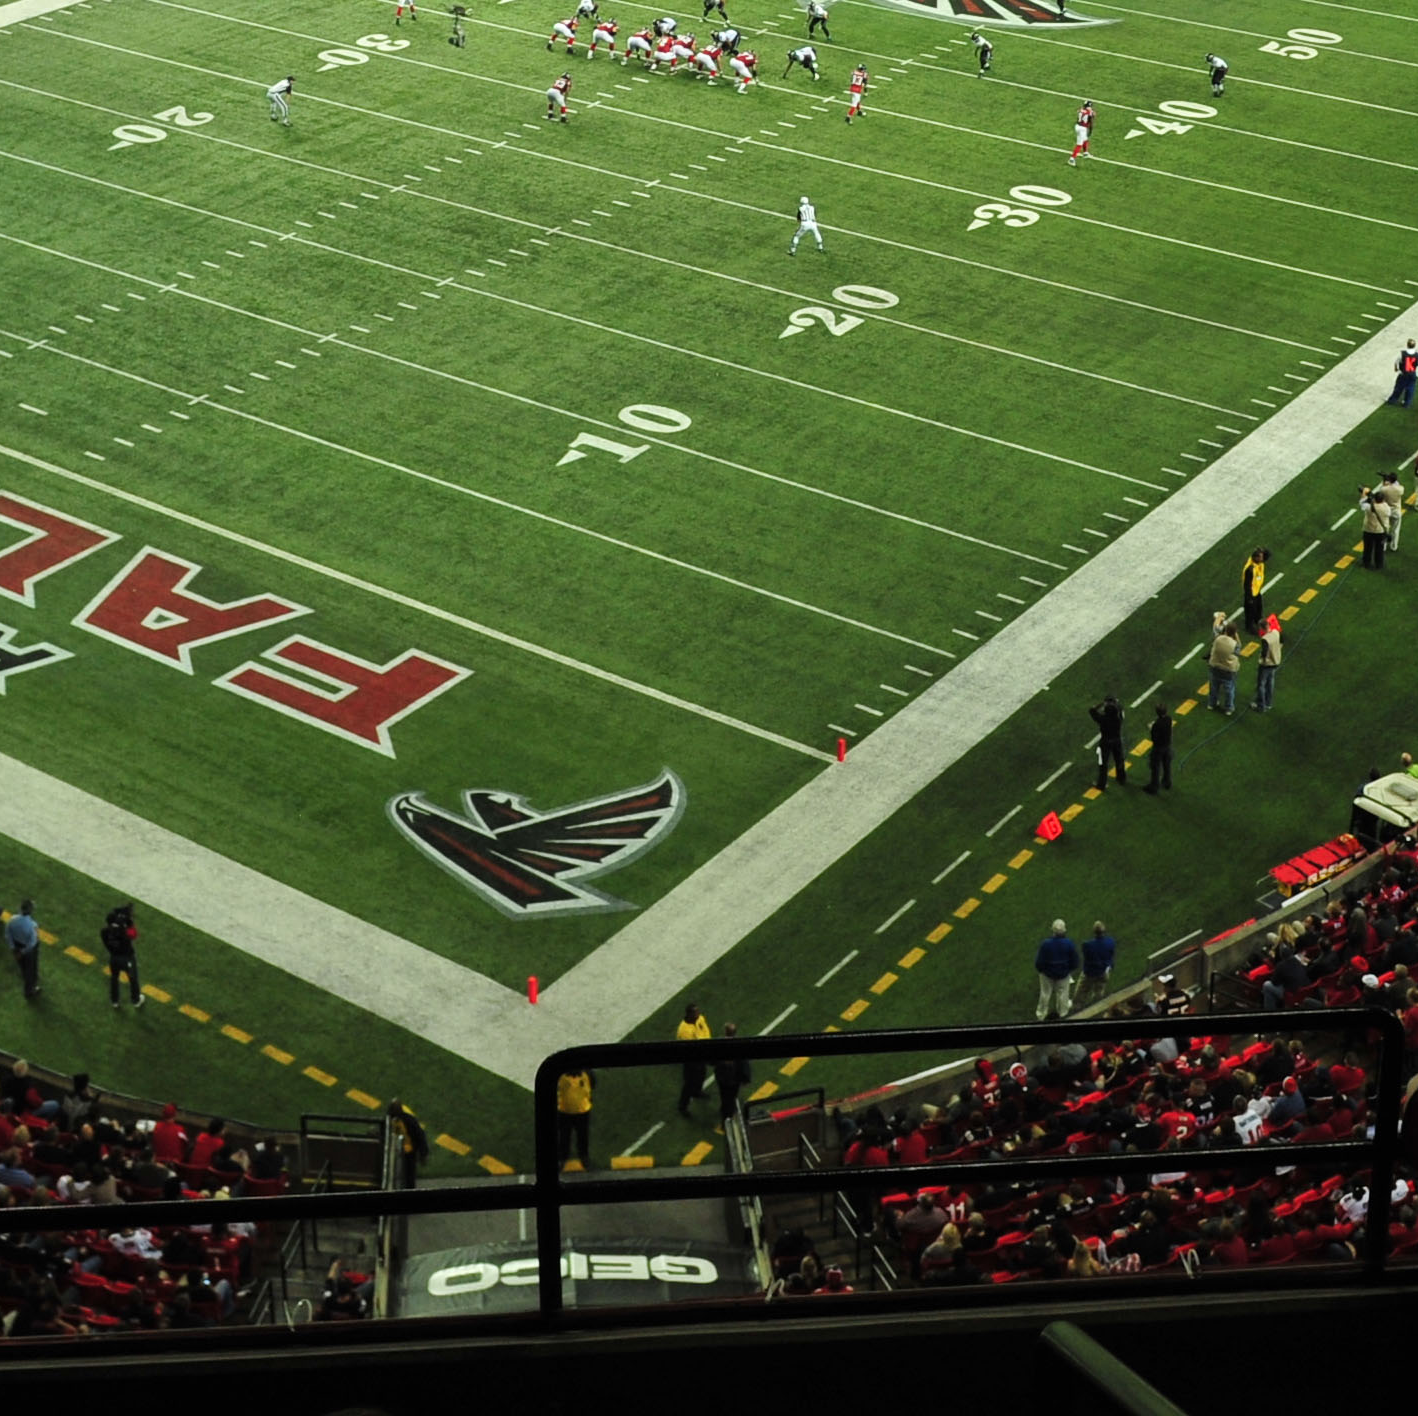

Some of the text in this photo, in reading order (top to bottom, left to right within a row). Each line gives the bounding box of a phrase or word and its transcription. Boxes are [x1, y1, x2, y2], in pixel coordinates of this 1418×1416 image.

[319, 33, 410, 66] 30
[1258, 28, 1343, 60] 50
[112, 106, 214, 145] 20
[1137, 100, 1218, 136] 40
[974, 185, 1073, 228] 30
[788, 285, 899, 337] 20
[1405, 357, 1417, 372] K
[571, 403, 692, 464] 10
[946, 1203, 966, 1221] 11
[428, 1252, 718, 1295] GEICO
